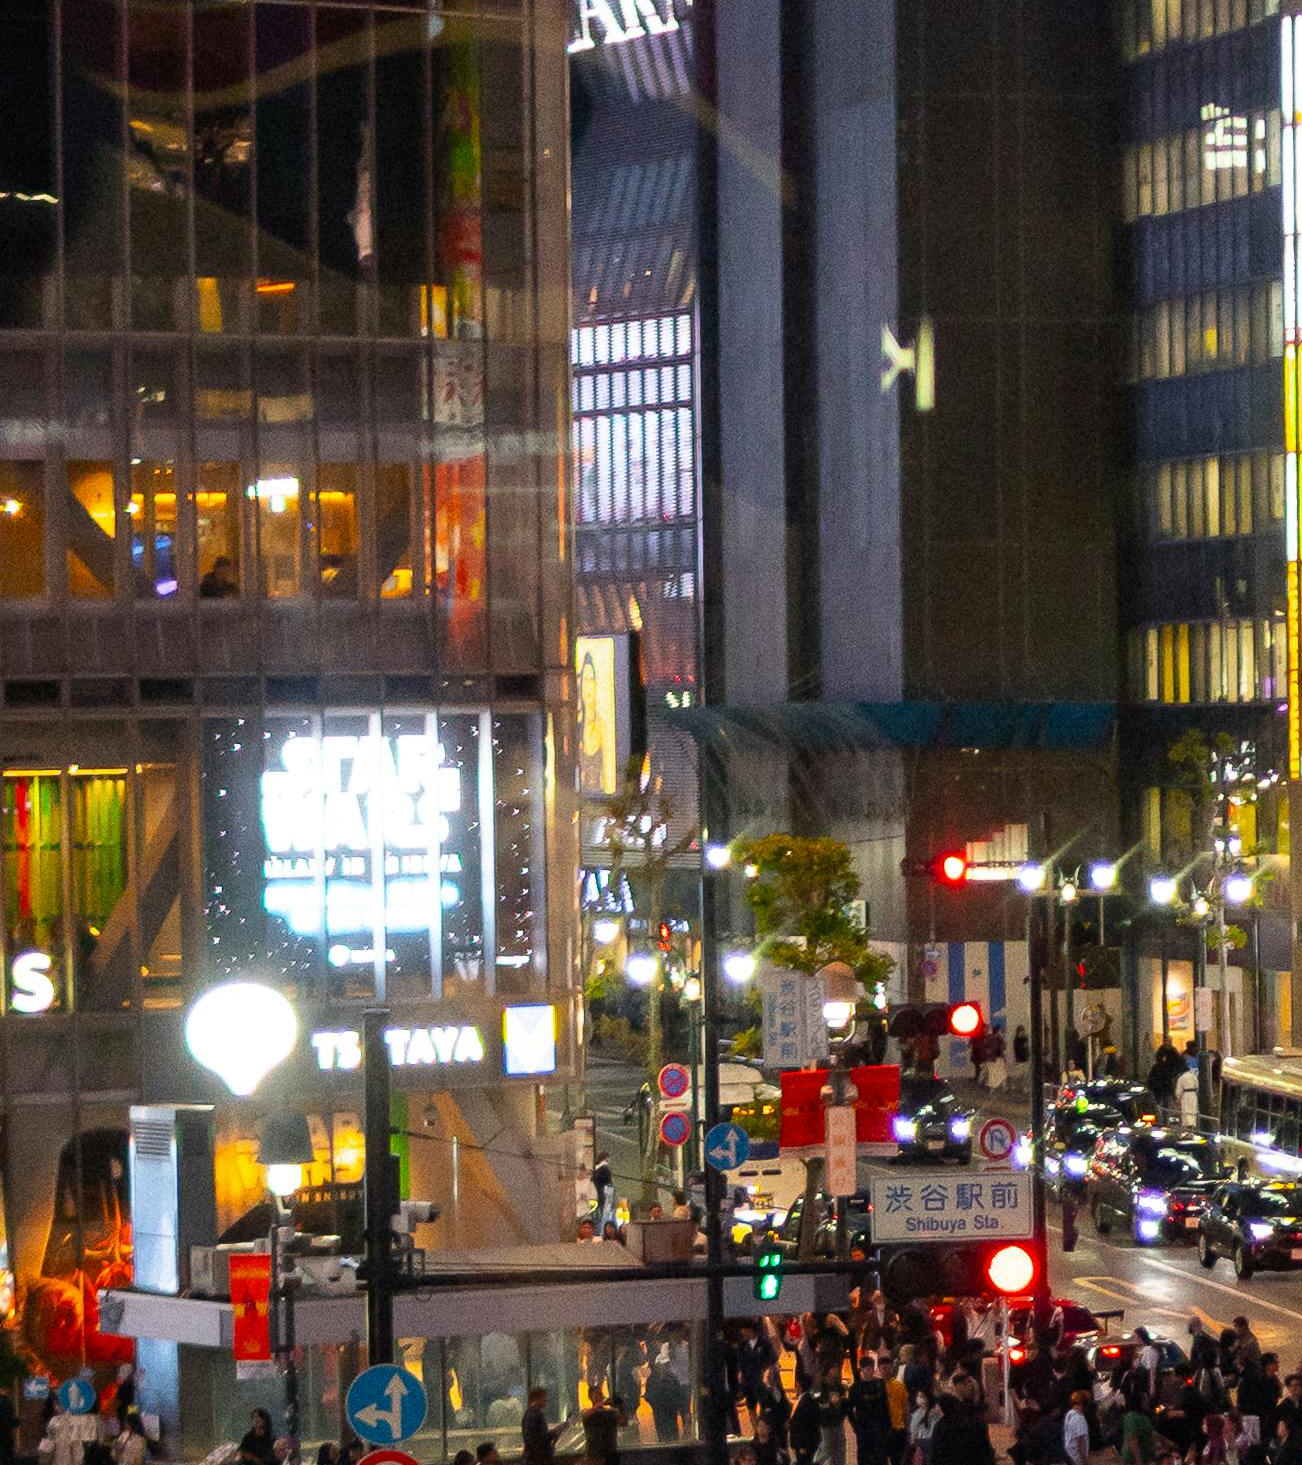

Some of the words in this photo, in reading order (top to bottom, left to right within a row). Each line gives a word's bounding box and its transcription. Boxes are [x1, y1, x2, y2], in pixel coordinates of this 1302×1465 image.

[312, 1027, 486, 1070] TSTAYA
[885, 1182, 1019, 1213] 渋谷駅前
[906, 1215, 967, 1233] Shibuya
[974, 1214, 1004, 1230] Sta.
